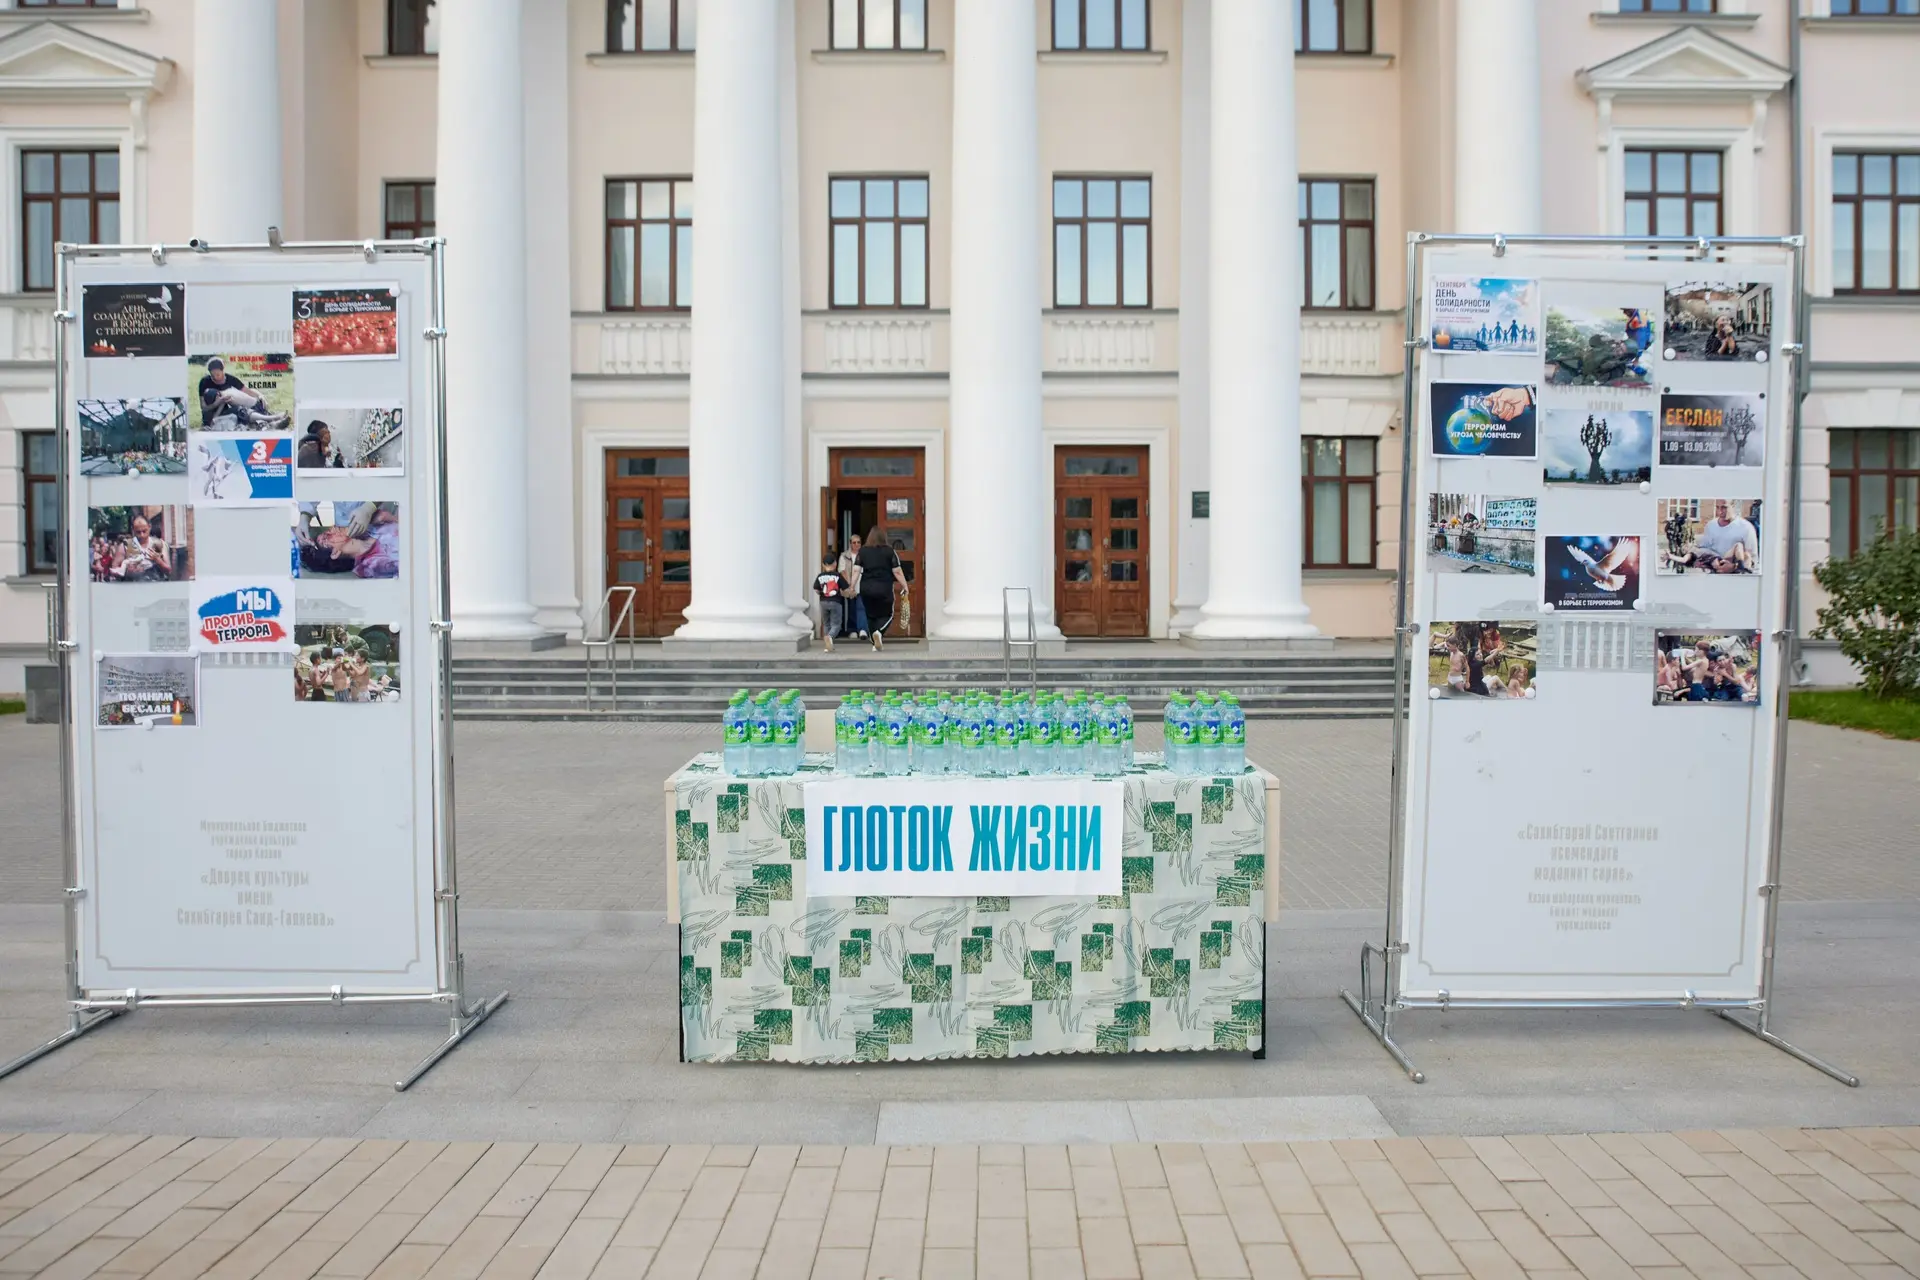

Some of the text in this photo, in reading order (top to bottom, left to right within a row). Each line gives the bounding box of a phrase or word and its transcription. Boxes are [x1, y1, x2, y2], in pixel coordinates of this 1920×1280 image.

[1436, 289, 1456, 298] ДЕНЬ
[122, 304, 146, 314] ДЕНЬ
[297, 298, 311, 319] 3
[1436, 298, 1490, 307] СОЛИДАРНОСТИ
[93, 312, 172, 321] СОЛИДАРНОСТИ
[105, 327, 172, 335] ТЕРРОРИЗМОМ
[120, 320, 154, 328] БОРЬБЕ
[1666, 408, 1723, 426] БЕСЛАН
[252, 441, 267, 460] 3
[236, 590, 272, 610] МЫ
[204, 612, 254, 630] ПРОТИВ
[217, 624, 270, 641] ТЕРРОРА
[119, 692, 174, 701] ПОМНИМ
[121, 705, 171, 713] БЕСЛАН
[823, 804, 1101, 872] ГЛОТОК ЖИЗНИ
[254, 870, 309, 887] культуры
[237, 891, 274, 905] имени
